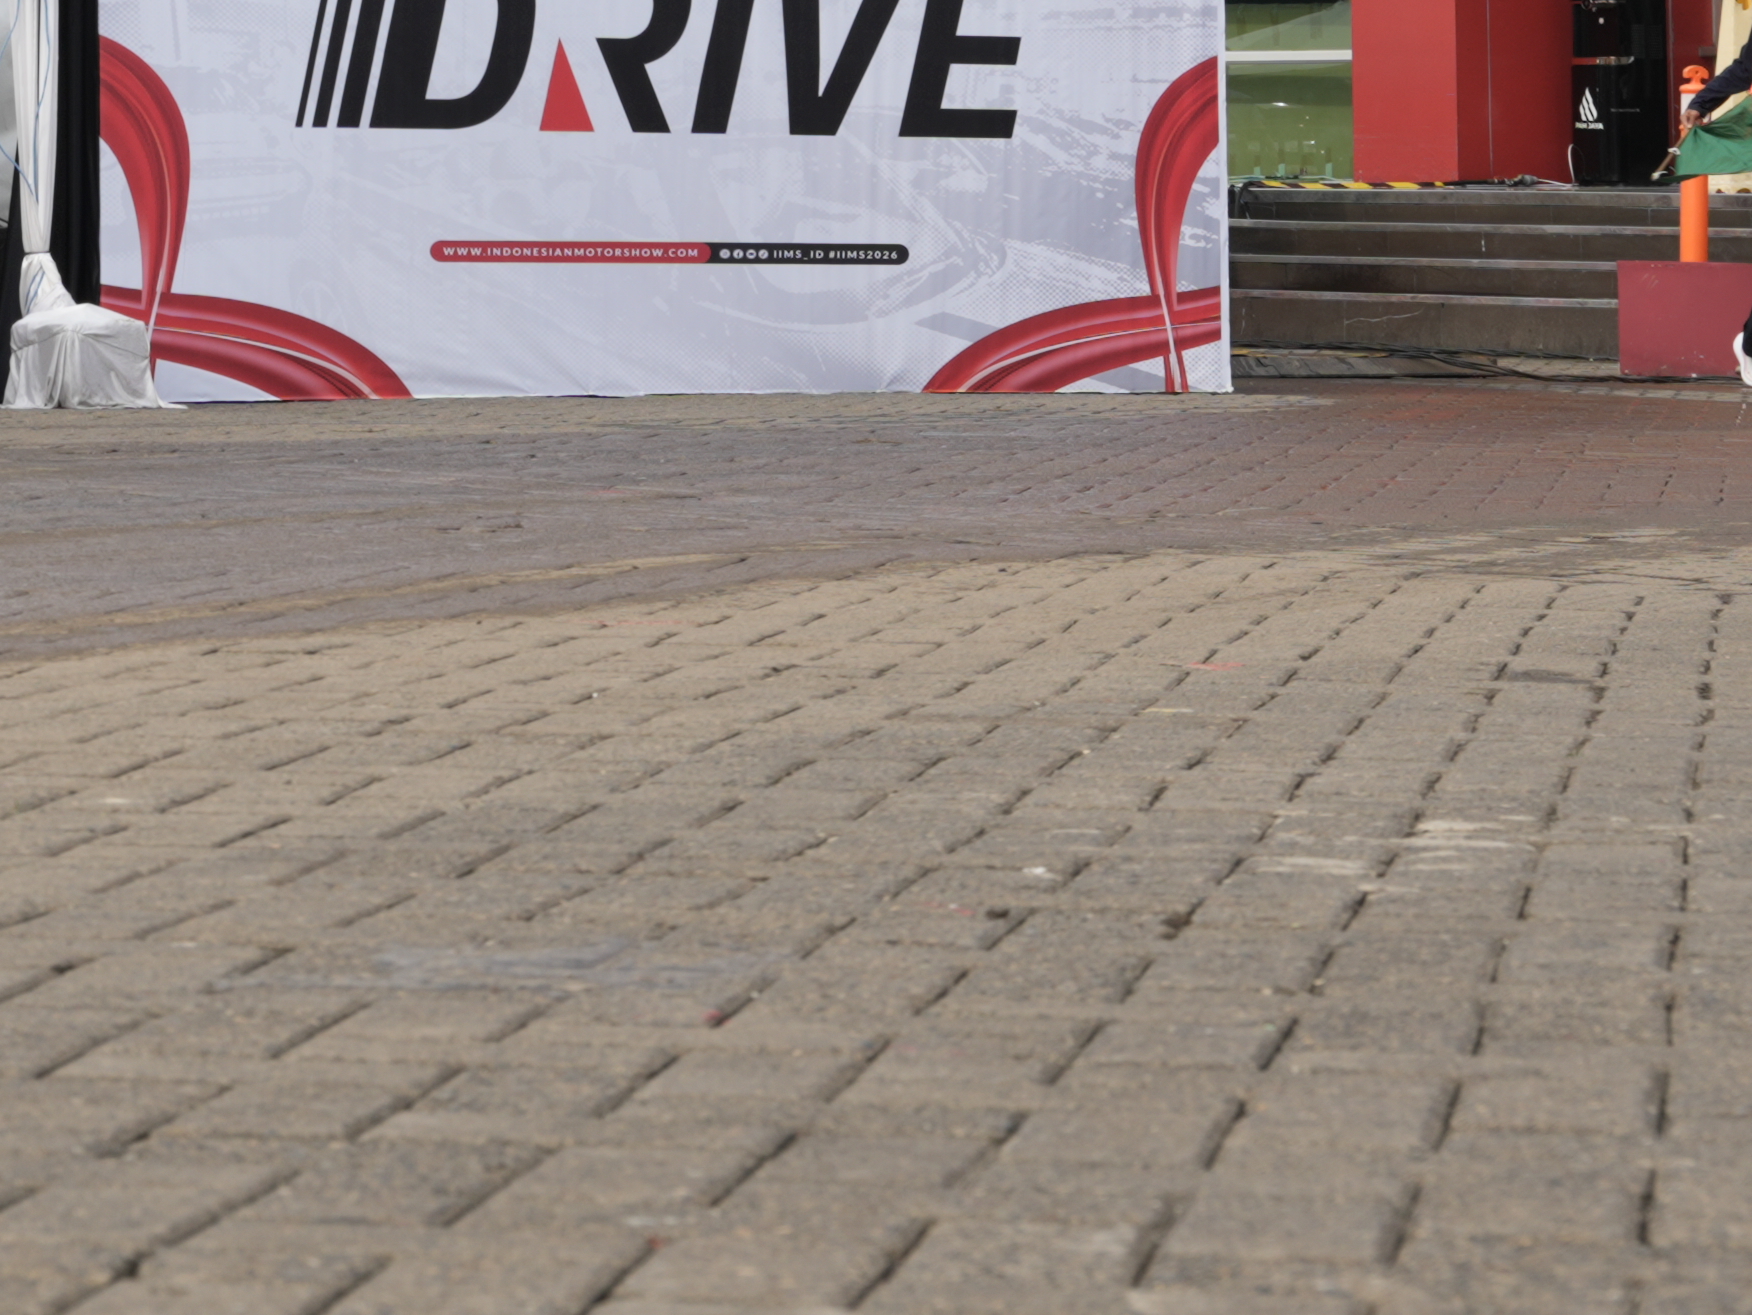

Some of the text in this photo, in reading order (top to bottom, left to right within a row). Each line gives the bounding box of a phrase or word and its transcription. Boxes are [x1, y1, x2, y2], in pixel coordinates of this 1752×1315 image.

[442, 246, 898, 260] WWW.INDONESIANMOTORSHOW.COM IIMS_ID #IIMS2026
